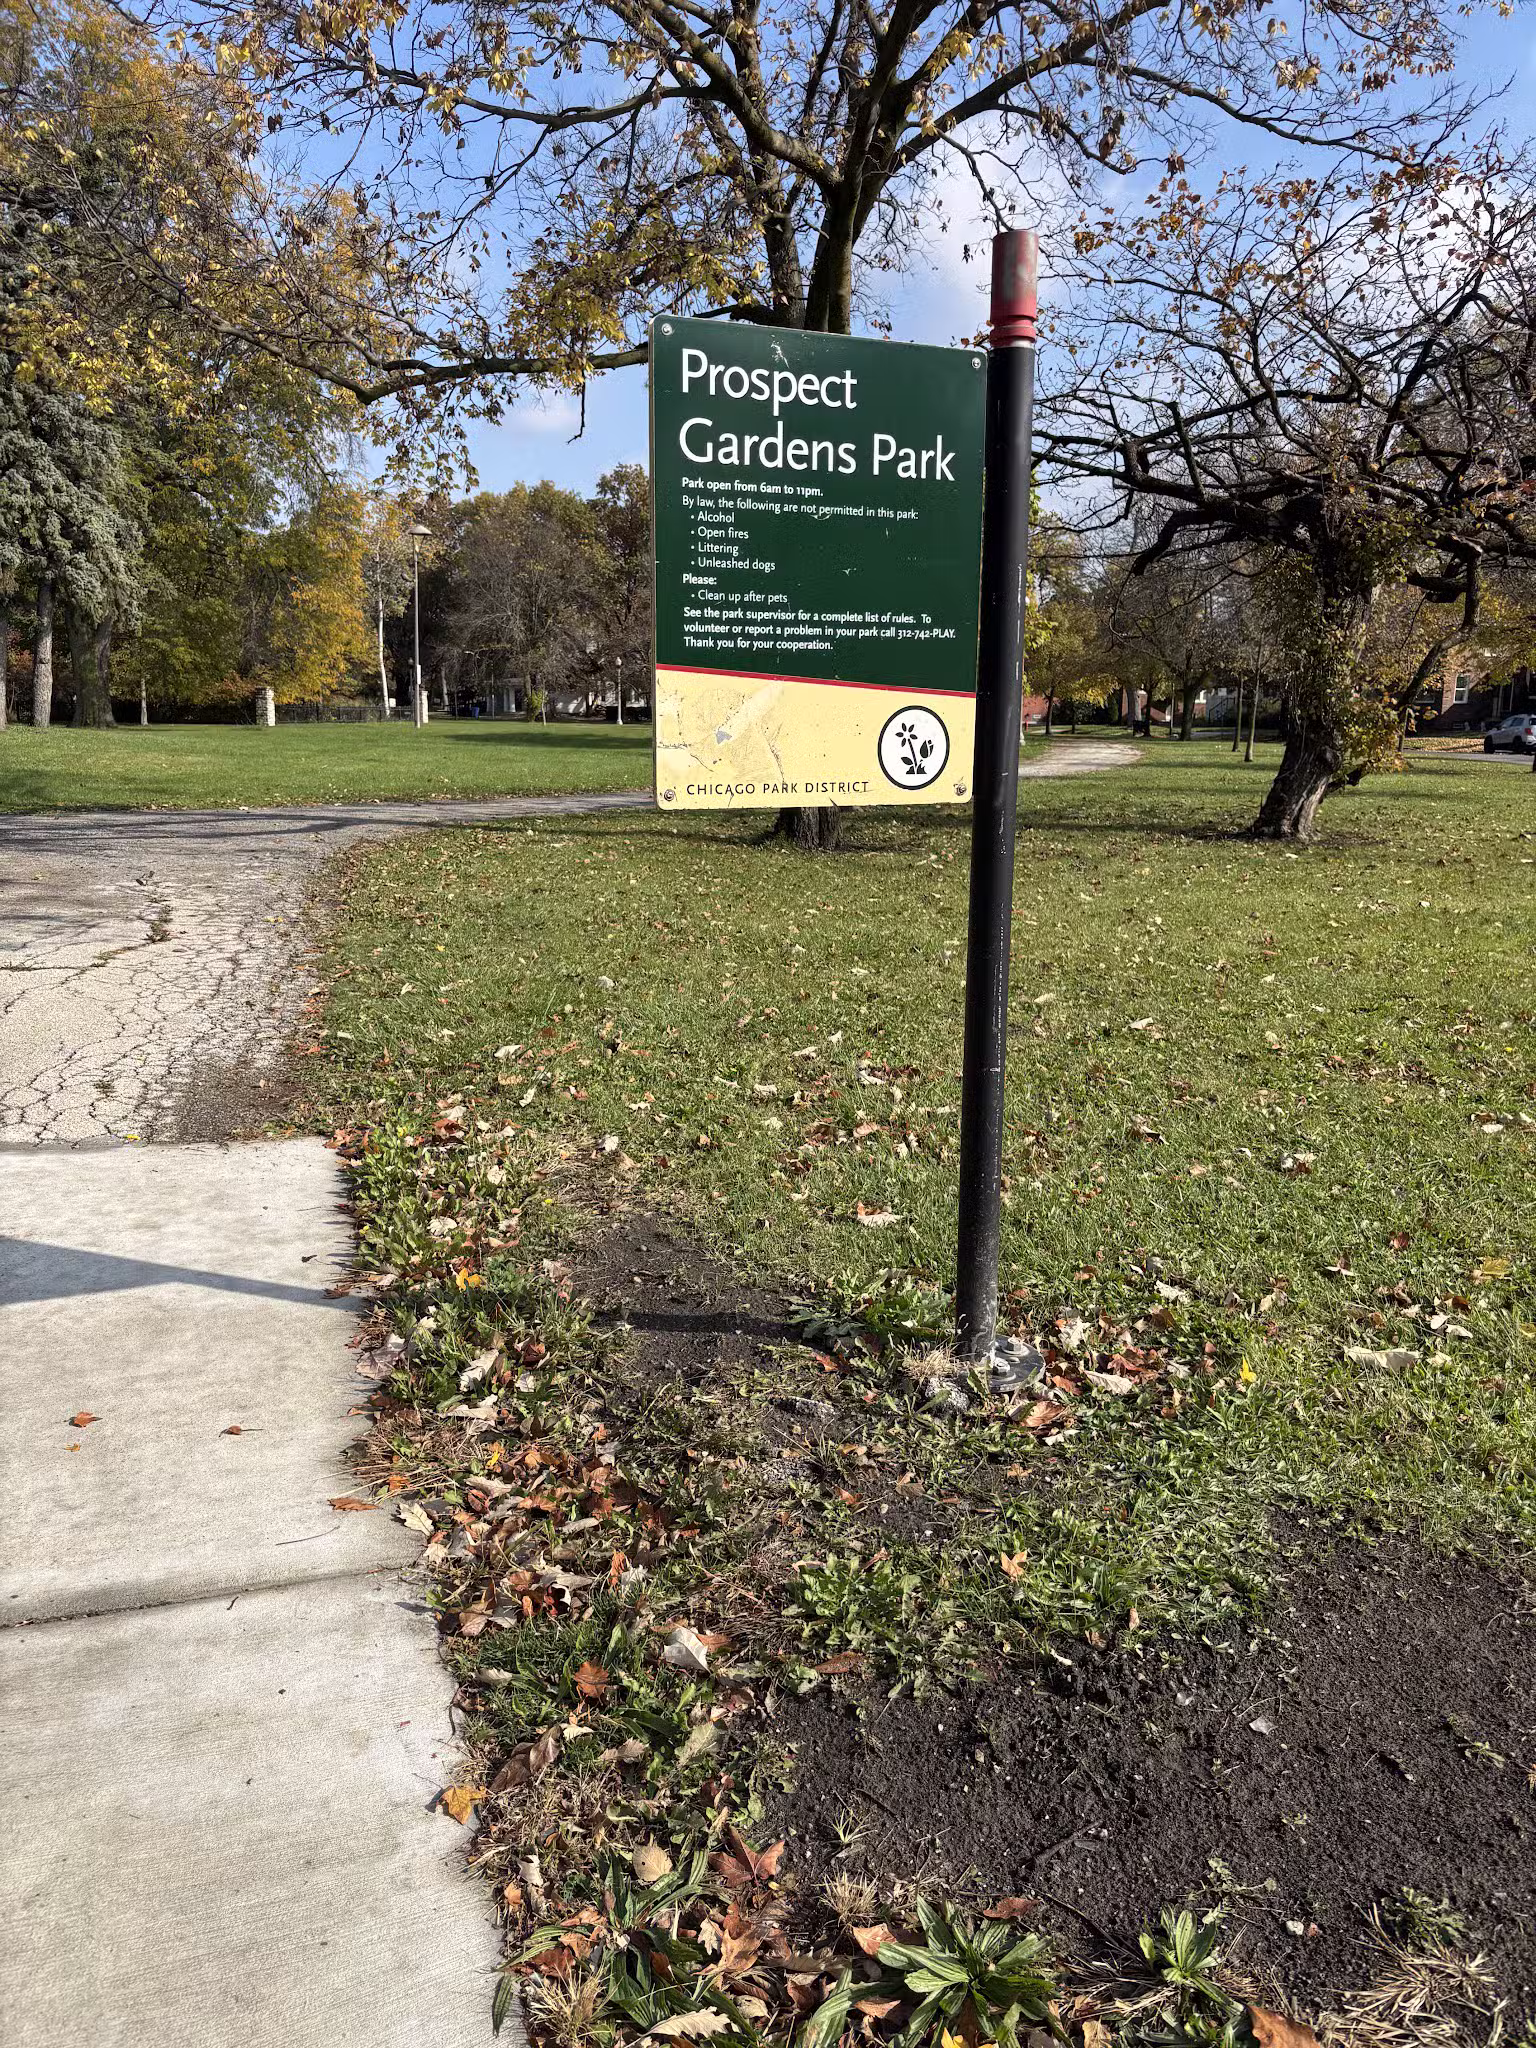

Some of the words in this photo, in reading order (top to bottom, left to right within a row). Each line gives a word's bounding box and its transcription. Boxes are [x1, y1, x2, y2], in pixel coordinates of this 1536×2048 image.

[681, 347, 858, 417] Prospect
[679, 417, 857, 475] Gardens
[872, 433, 956, 482] Park
[682, 477, 704, 489] Park
[706, 480, 731, 492] open
[734, 480, 757, 492] from
[760, 482, 781, 494] 6am
[784, 484, 794, 495] to
[796, 486, 824, 498] 11pm.
[682, 495, 694, 509] By
[697, 495, 716, 509] law,
[718, 497, 734, 509] the
[737, 498, 781, 514] following
[783, 503, 798, 512] are
[800, 504, 817, 514] not
[819, 505, 864, 517] permitted
[866, 507, 875, 517] in
[877, 507, 894, 518] this
[896, 508, 919, 521] park:
[697, 511, 735, 523] Alcohol
[697, 526, 725, 540] Open
[728, 527, 749, 539] fires
[698, 541, 739, 557] Littering
[698, 557, 749, 569] Unleashed
[752, 558, 776, 573] dogs
[682, 573, 717, 585] Please:
[698, 589, 725, 601] Clean
[728, 593, 741, 604] up
[743, 590, 765, 602] after
[768, 593, 788, 605] pets
[683, 607, 701, 618] See
[704, 607, 720, 618] the
[722, 607, 744, 621] park
[746, 609, 796, 622] supervisor
[797, 609, 811, 620] for
[813, 612, 819, 621] a
[821, 611, 863, 624] complete
[865, 612, 879, 623] list
[880, 612, 892, 623] of
[892, 612, 916, 623] rules.
[921, 613, 932, 624] To
[683, 621, 730, 633] volunteer
[732, 625, 742, 633] or
[744, 625, 774, 636] report
[775, 627, 781, 635] a
[784, 624, 822, 637] problem
[825, 625, 834, 635] in
[835, 628, 857, 639] your
[858, 626, 879, 639] park
[880, 626, 896, 637] call
[897, 628, 956, 640] 312-742-PLAY.
[683, 636, 714, 648] Thank
[716, 639, 735, 650] you
[737, 637, 751, 648] for
[752, 640, 774, 651] your
[776, 639, 833, 652] cooperation.
[686, 783, 756, 795] CHICAGO
[763, 783, 799, 794] PARK
[805, 781, 869, 794] DISTRICT
